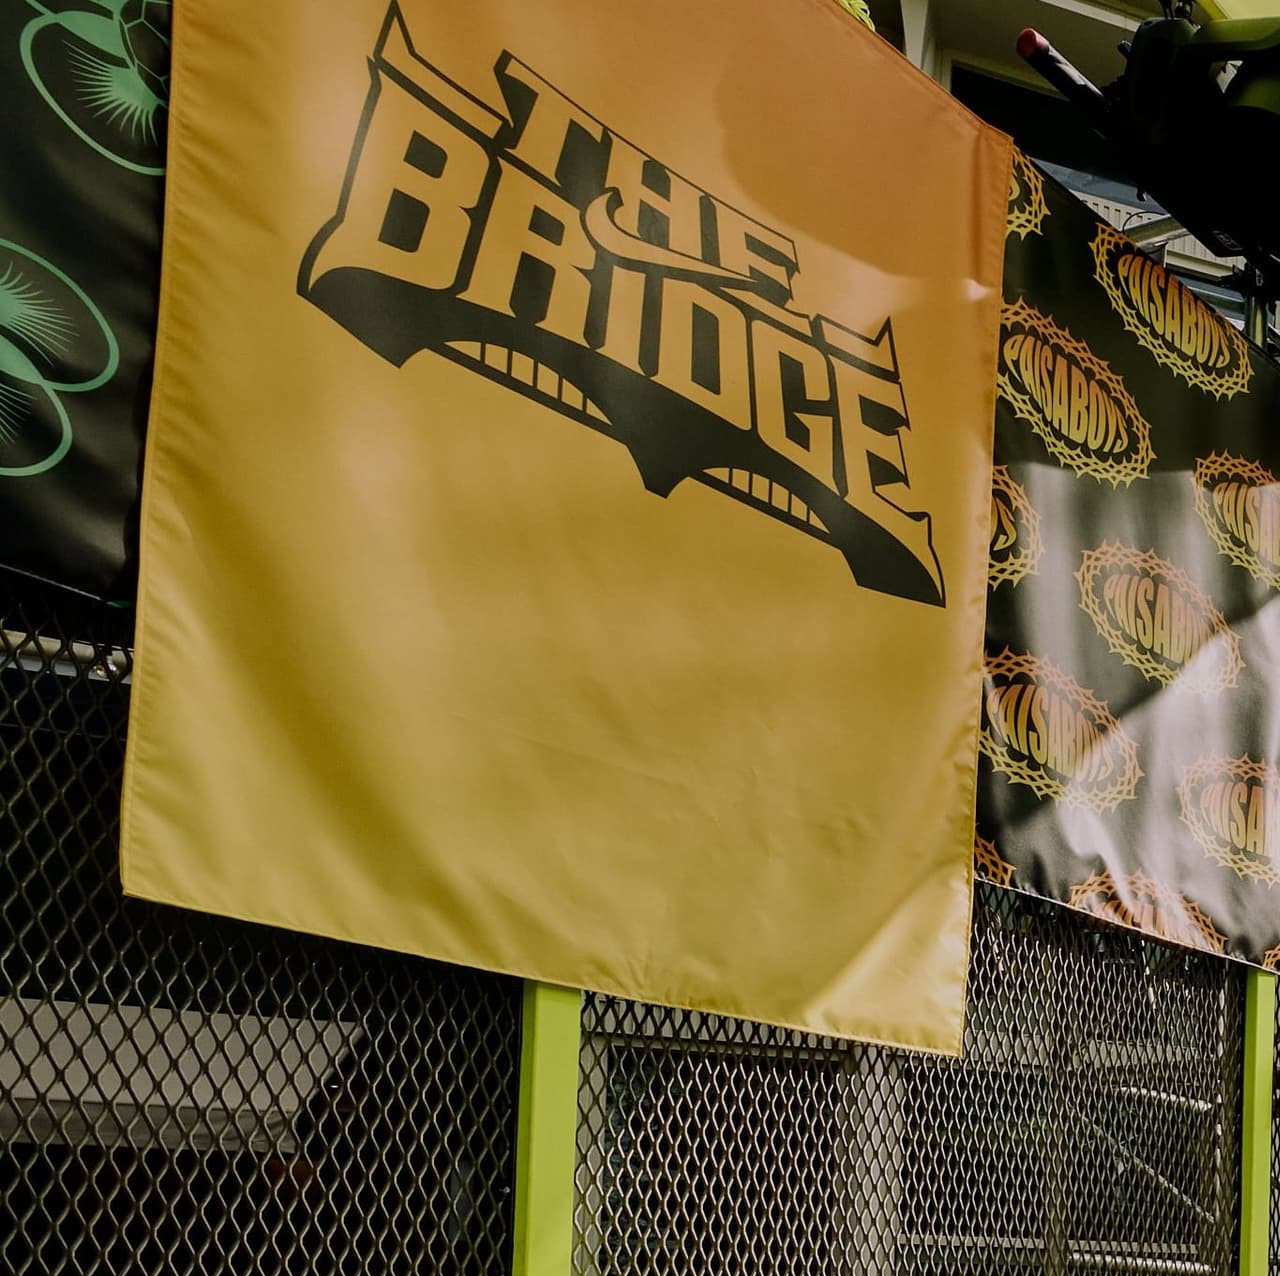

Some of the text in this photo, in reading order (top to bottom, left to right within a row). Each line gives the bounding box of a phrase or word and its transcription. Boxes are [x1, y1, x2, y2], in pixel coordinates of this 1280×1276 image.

[297, 58, 938, 532] BRIDGE
[492, 48, 801, 314] THE
[1003, 334, 1129, 453] PAISABOYS
